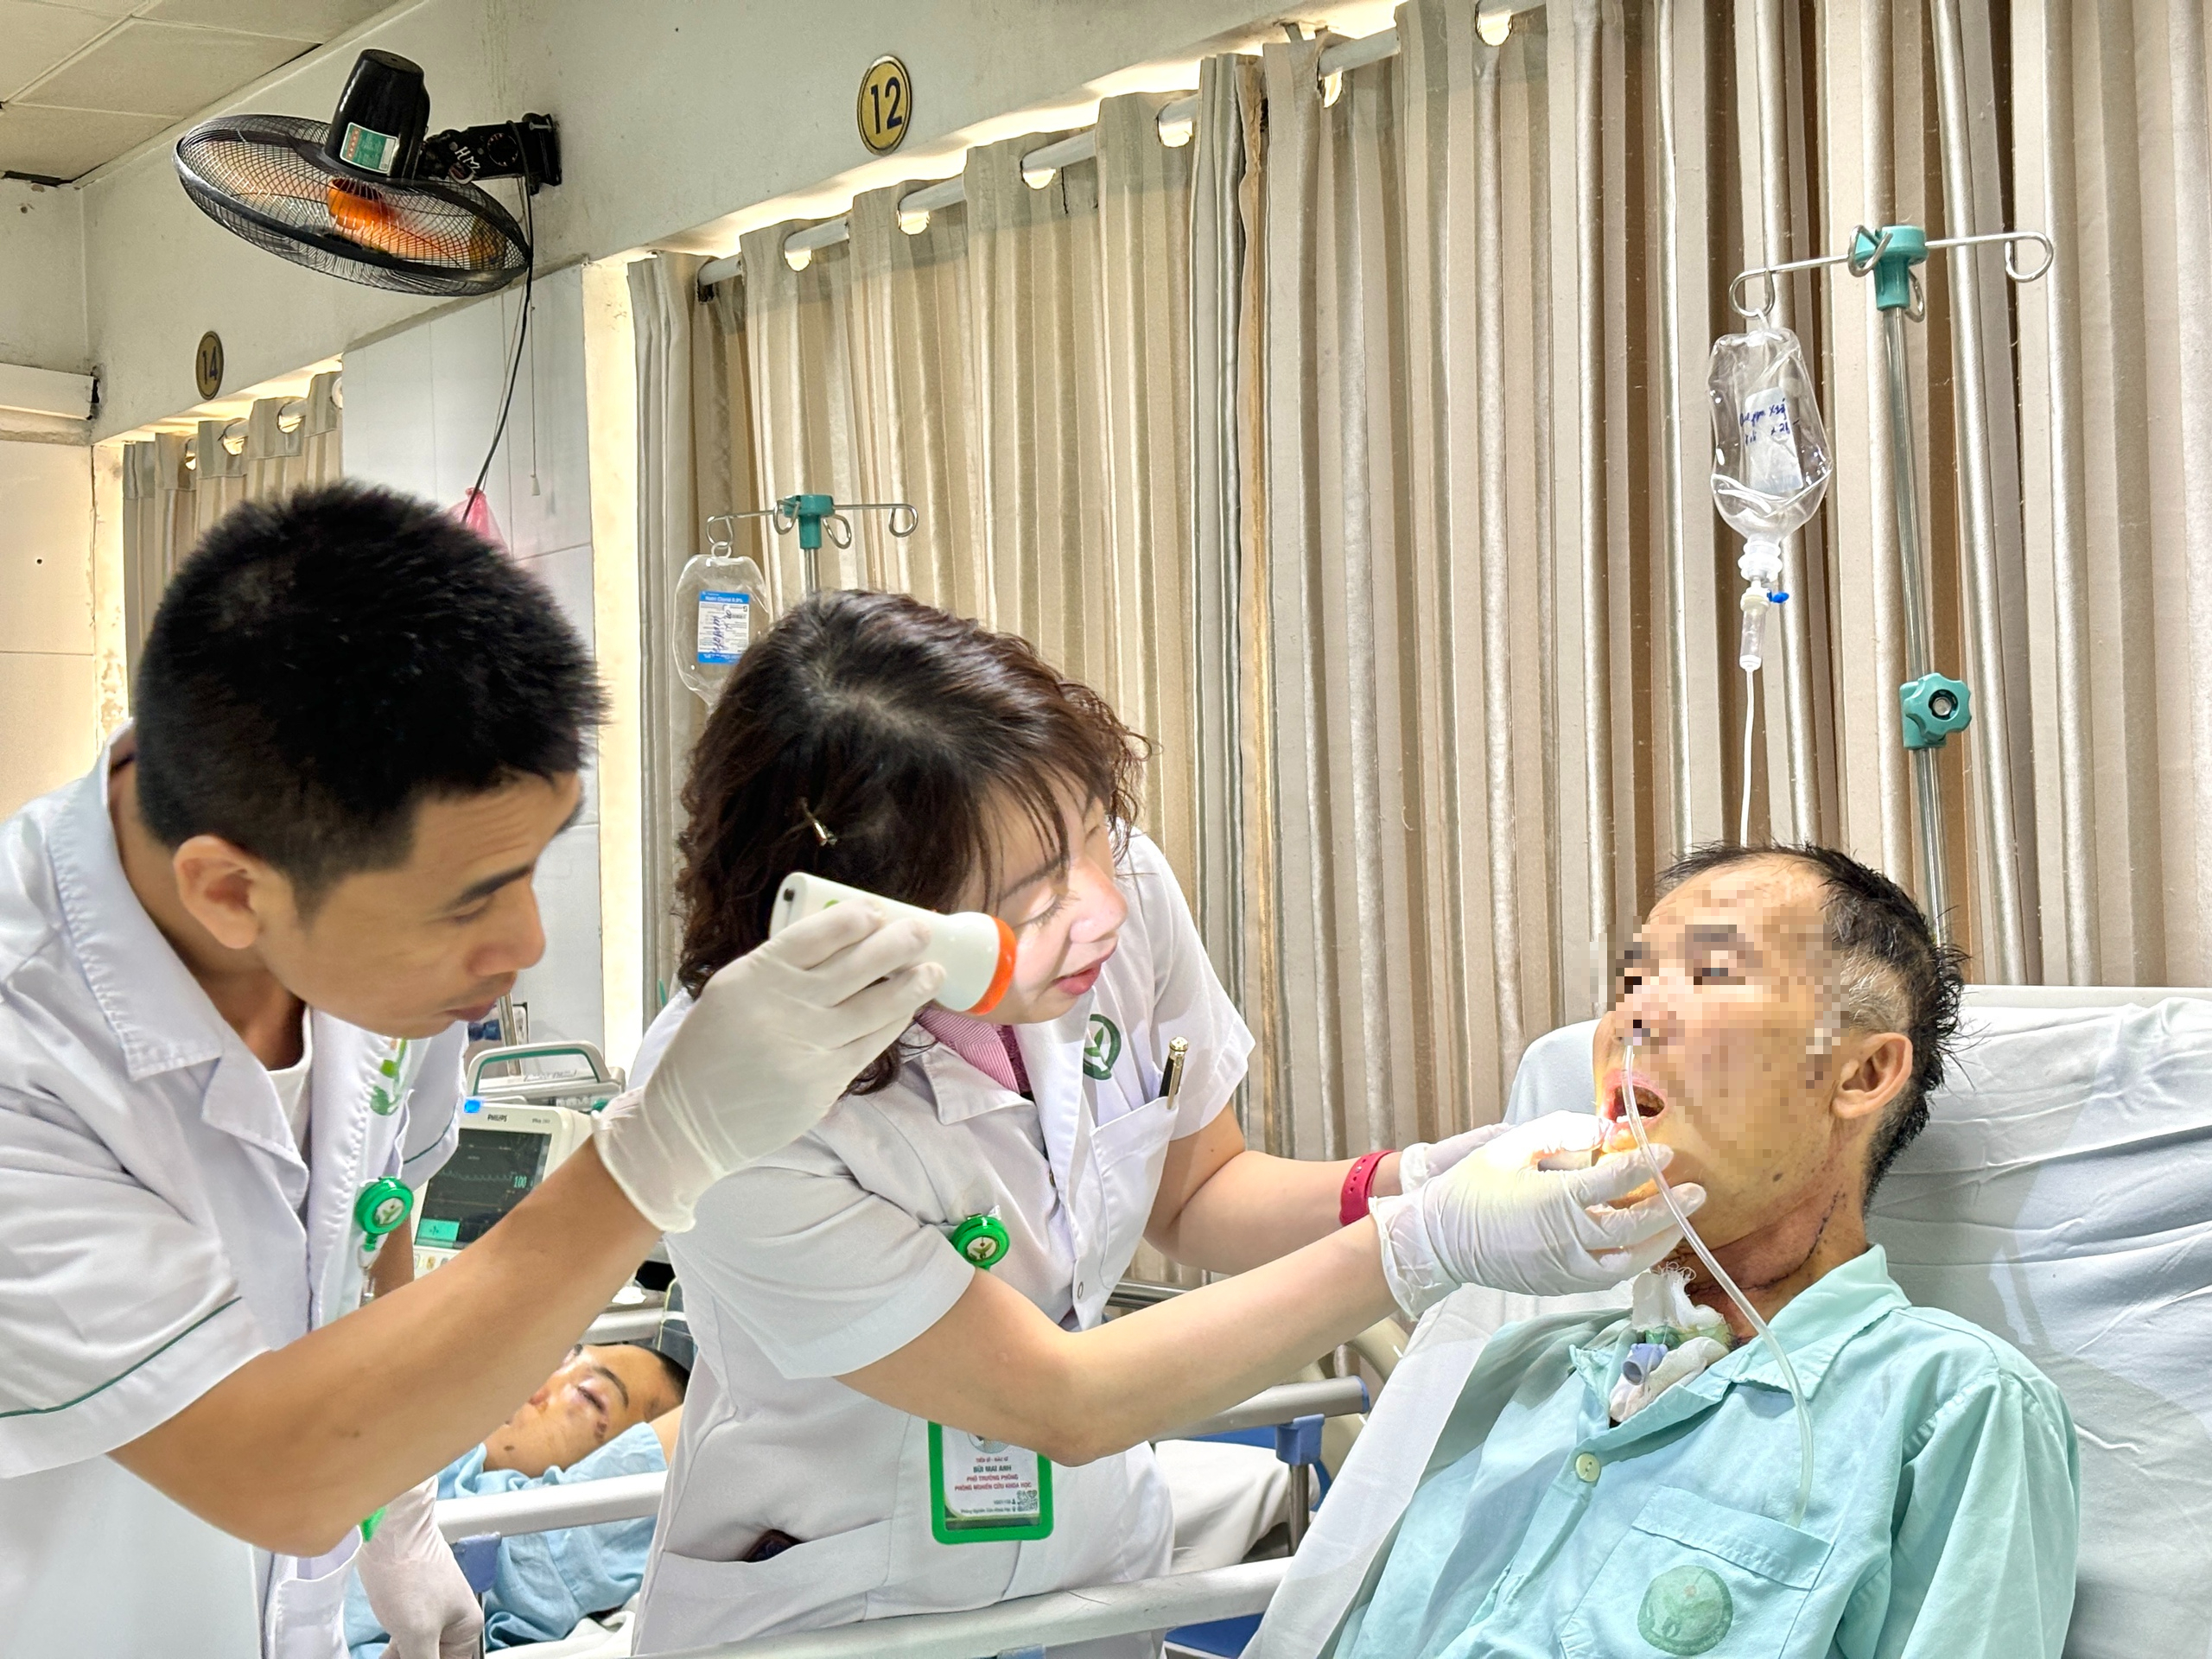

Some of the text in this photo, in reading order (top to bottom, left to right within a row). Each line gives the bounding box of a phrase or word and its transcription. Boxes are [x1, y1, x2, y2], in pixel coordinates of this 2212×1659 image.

[871, 77, 902, 134] 12
[202, 346, 218, 385] 14
[487, 1114, 507, 1122] PHILIPS
[513, 1176, 527, 1189] 100
